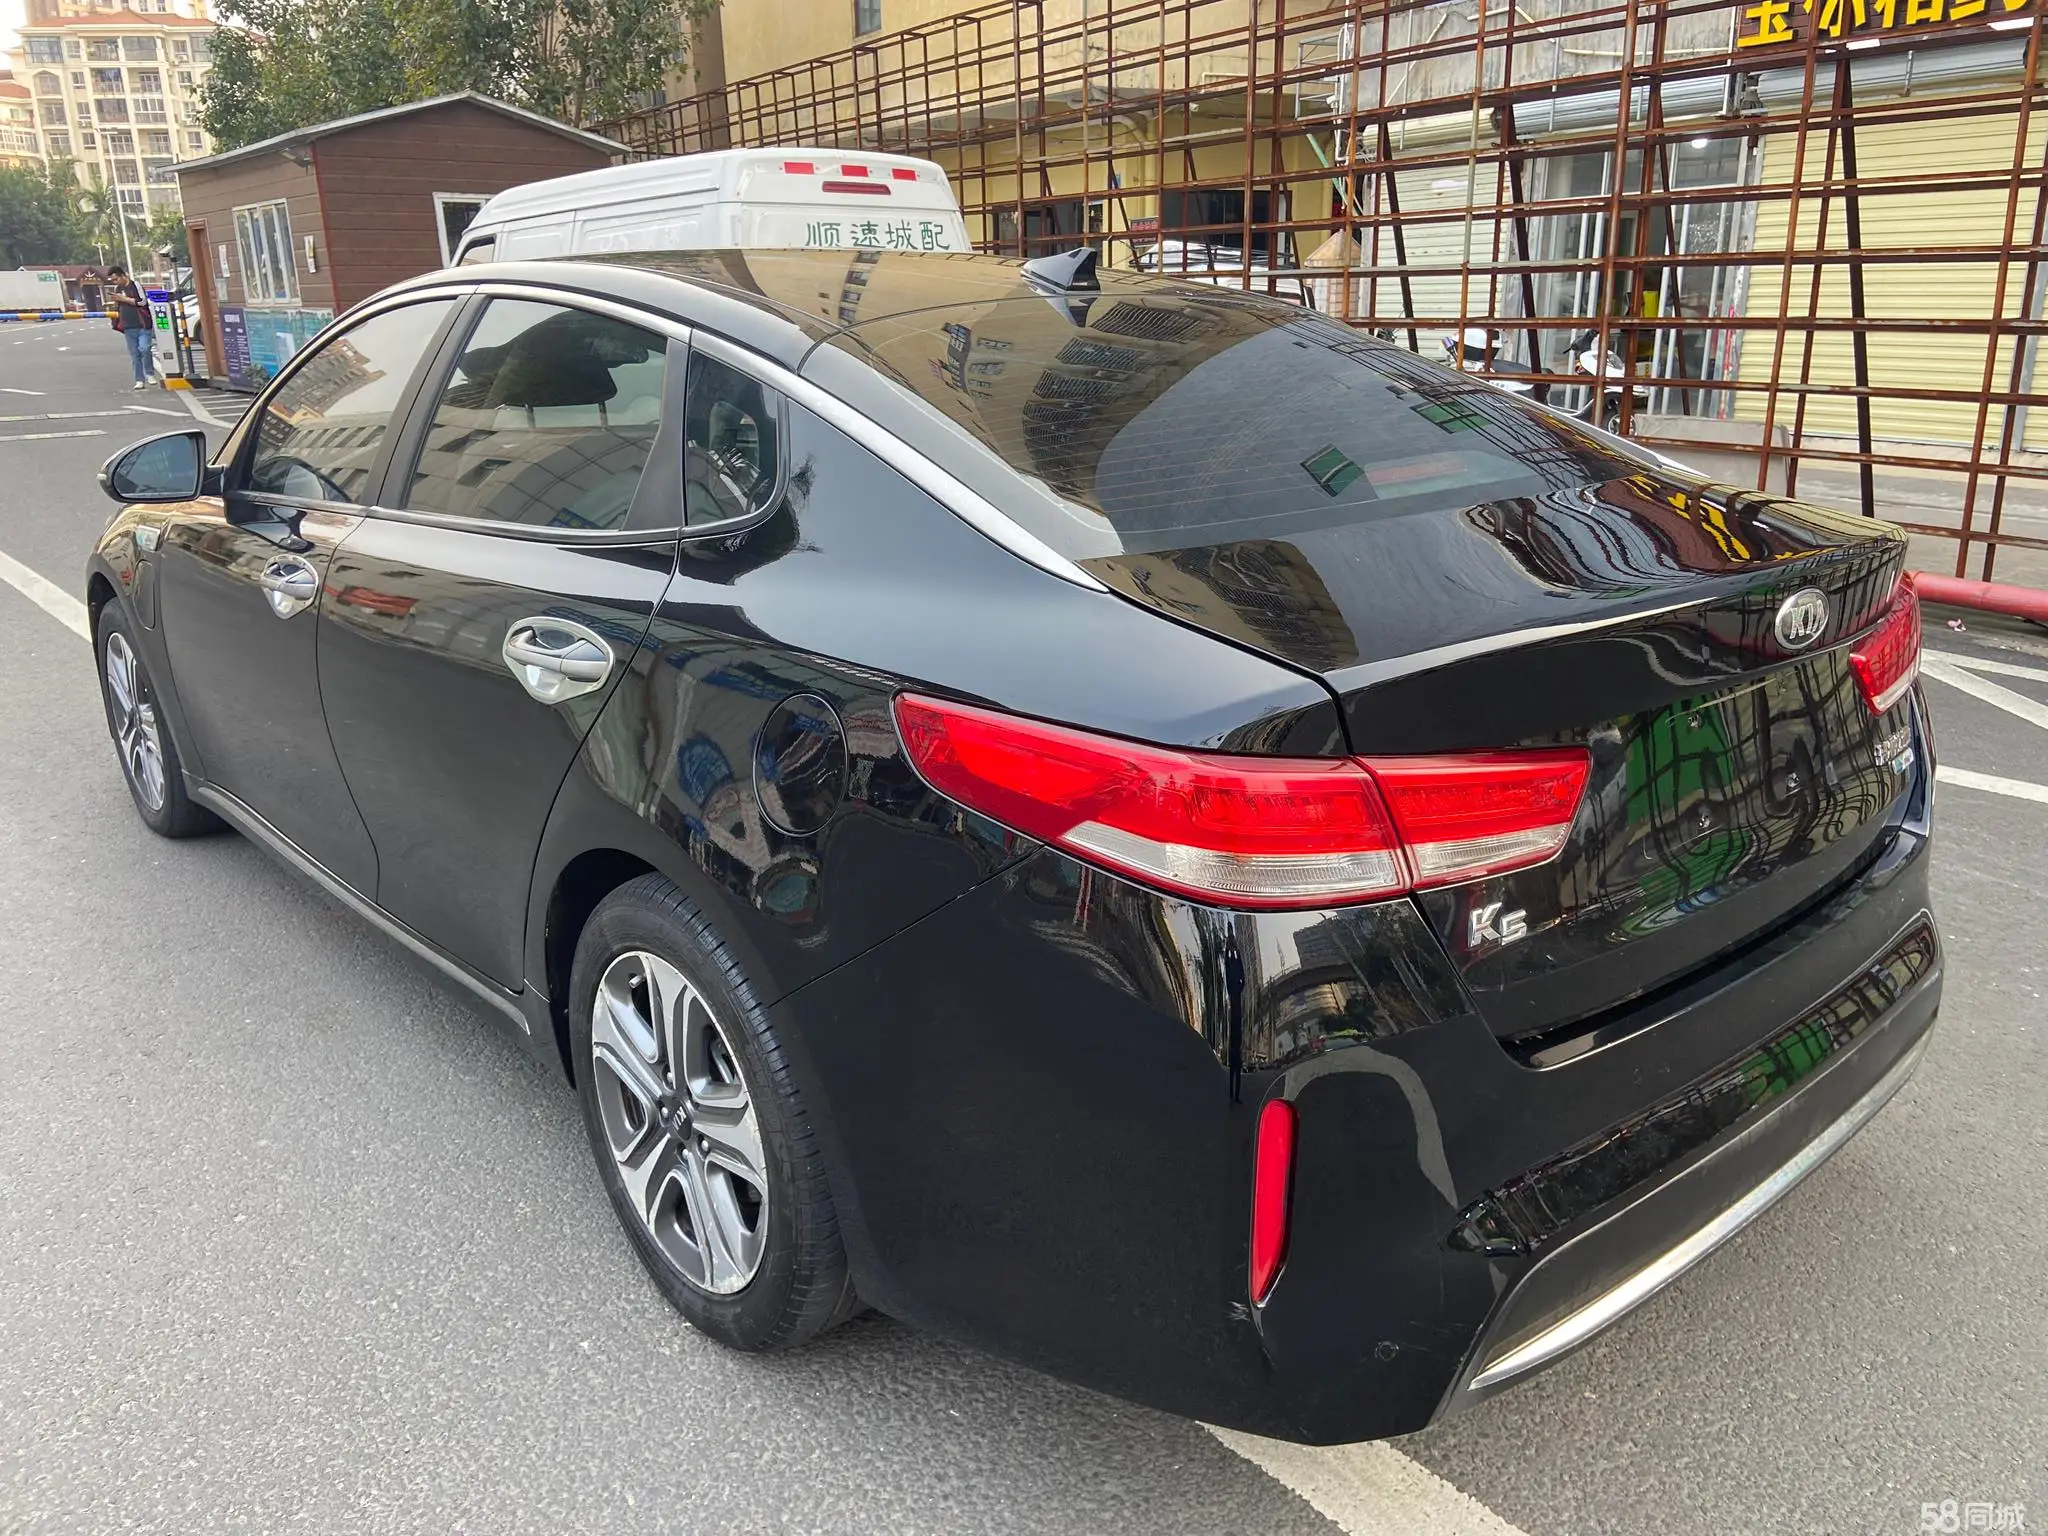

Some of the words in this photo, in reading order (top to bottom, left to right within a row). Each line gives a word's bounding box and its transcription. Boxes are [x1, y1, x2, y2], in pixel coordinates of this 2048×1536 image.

[805, 220, 950, 250] 顺速城配
[1789, 599, 1825, 639] KIA
[1468, 902, 1527, 948] K5
